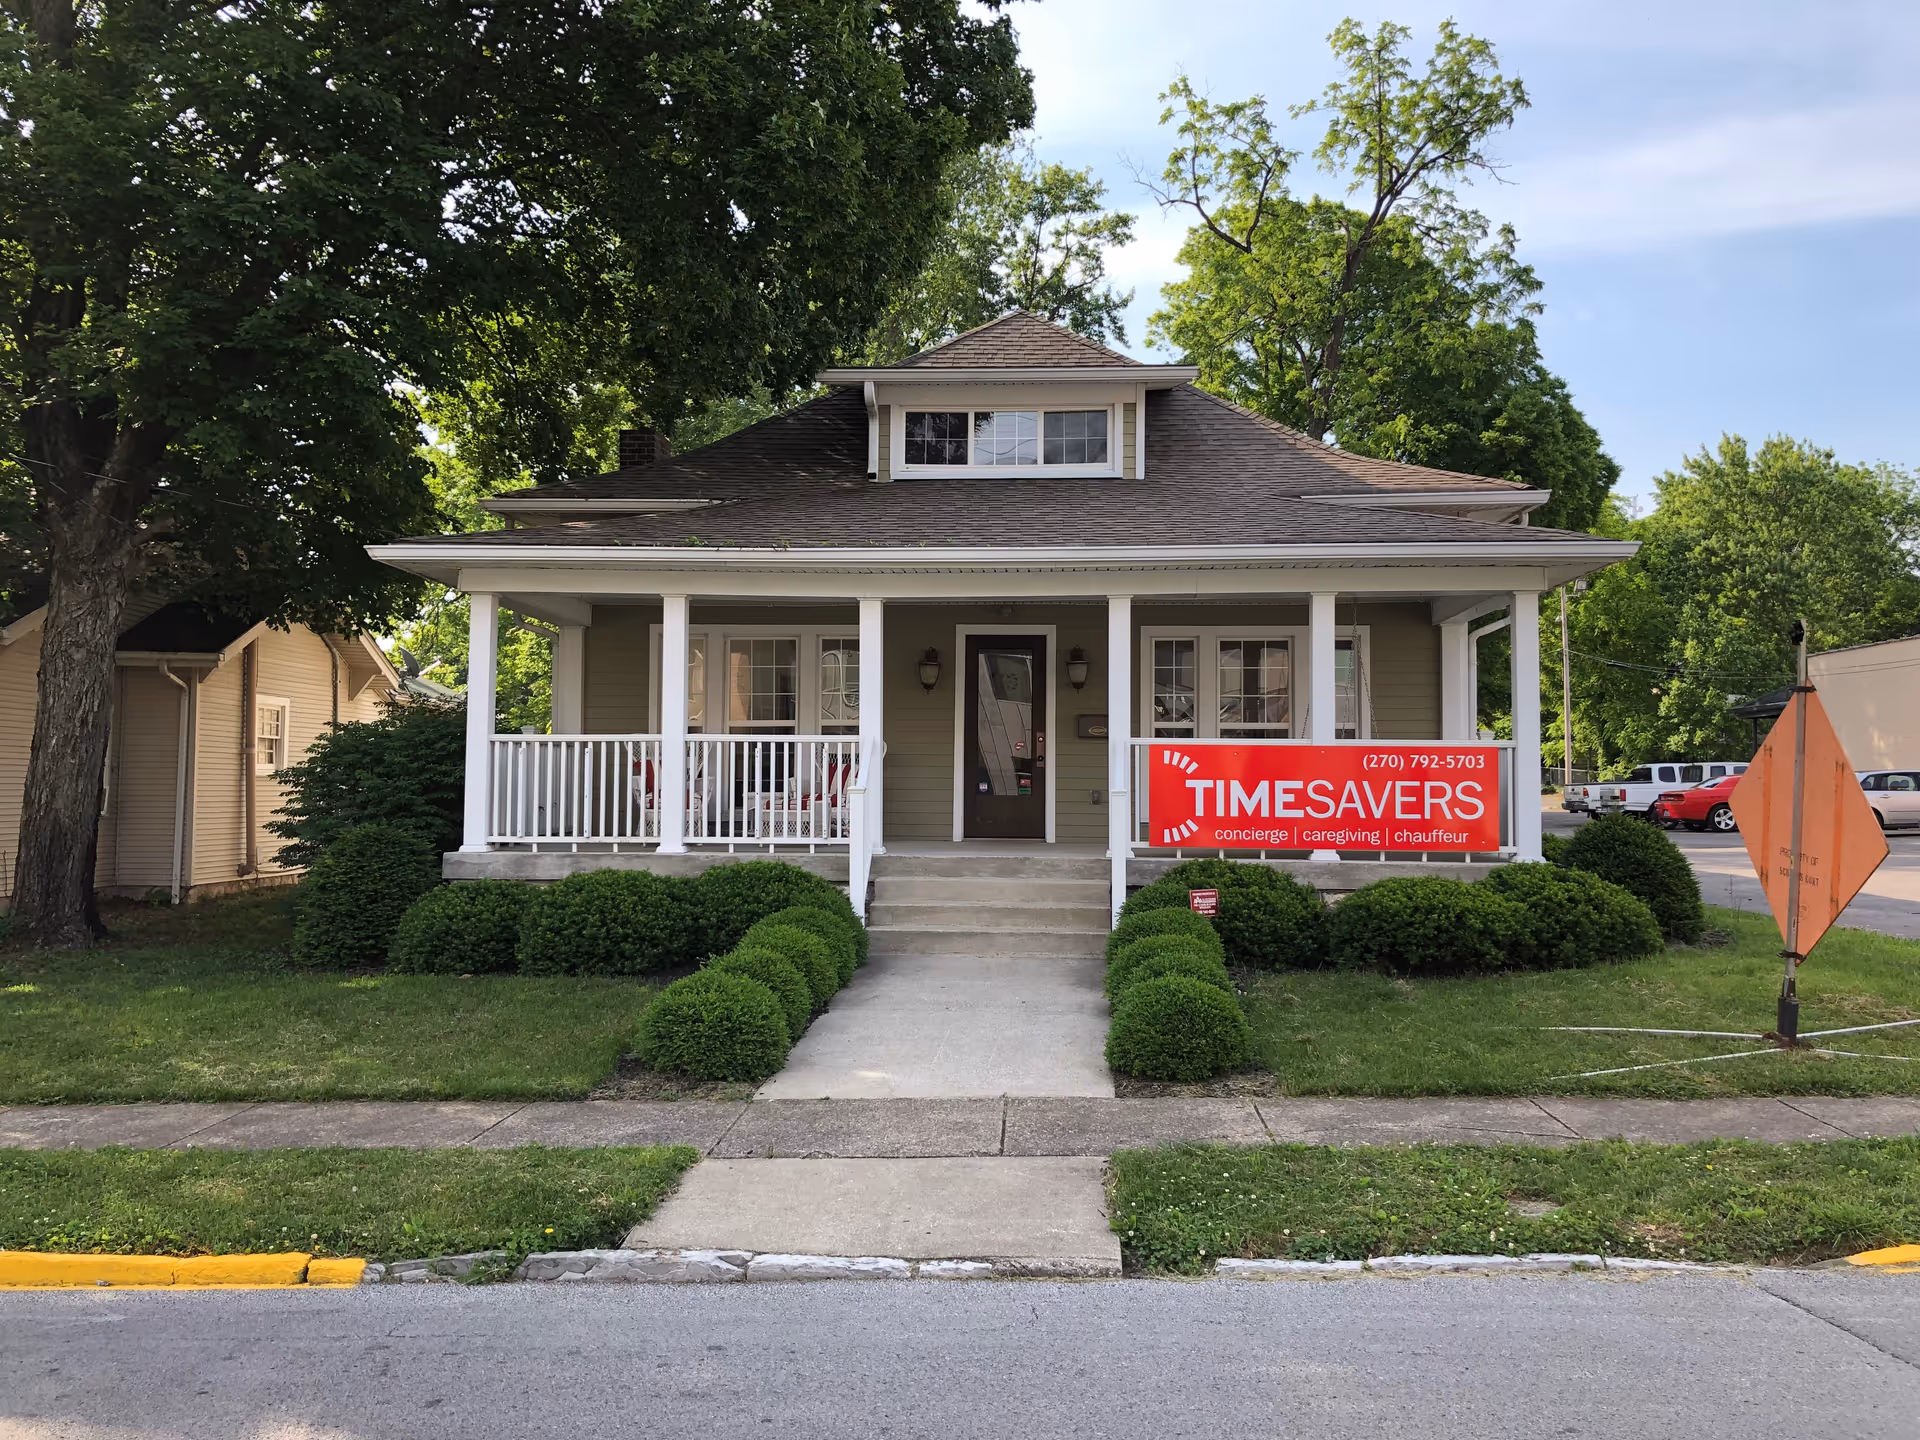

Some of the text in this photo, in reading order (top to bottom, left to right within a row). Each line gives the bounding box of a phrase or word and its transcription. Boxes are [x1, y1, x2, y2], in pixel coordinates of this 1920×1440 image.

[1363, 754, 1485, 771] (270) 792-5703
[1185, 779, 1485, 820] TIMESAVERS
[1214, 826, 1469, 845] concierge caregiving chauffeur
